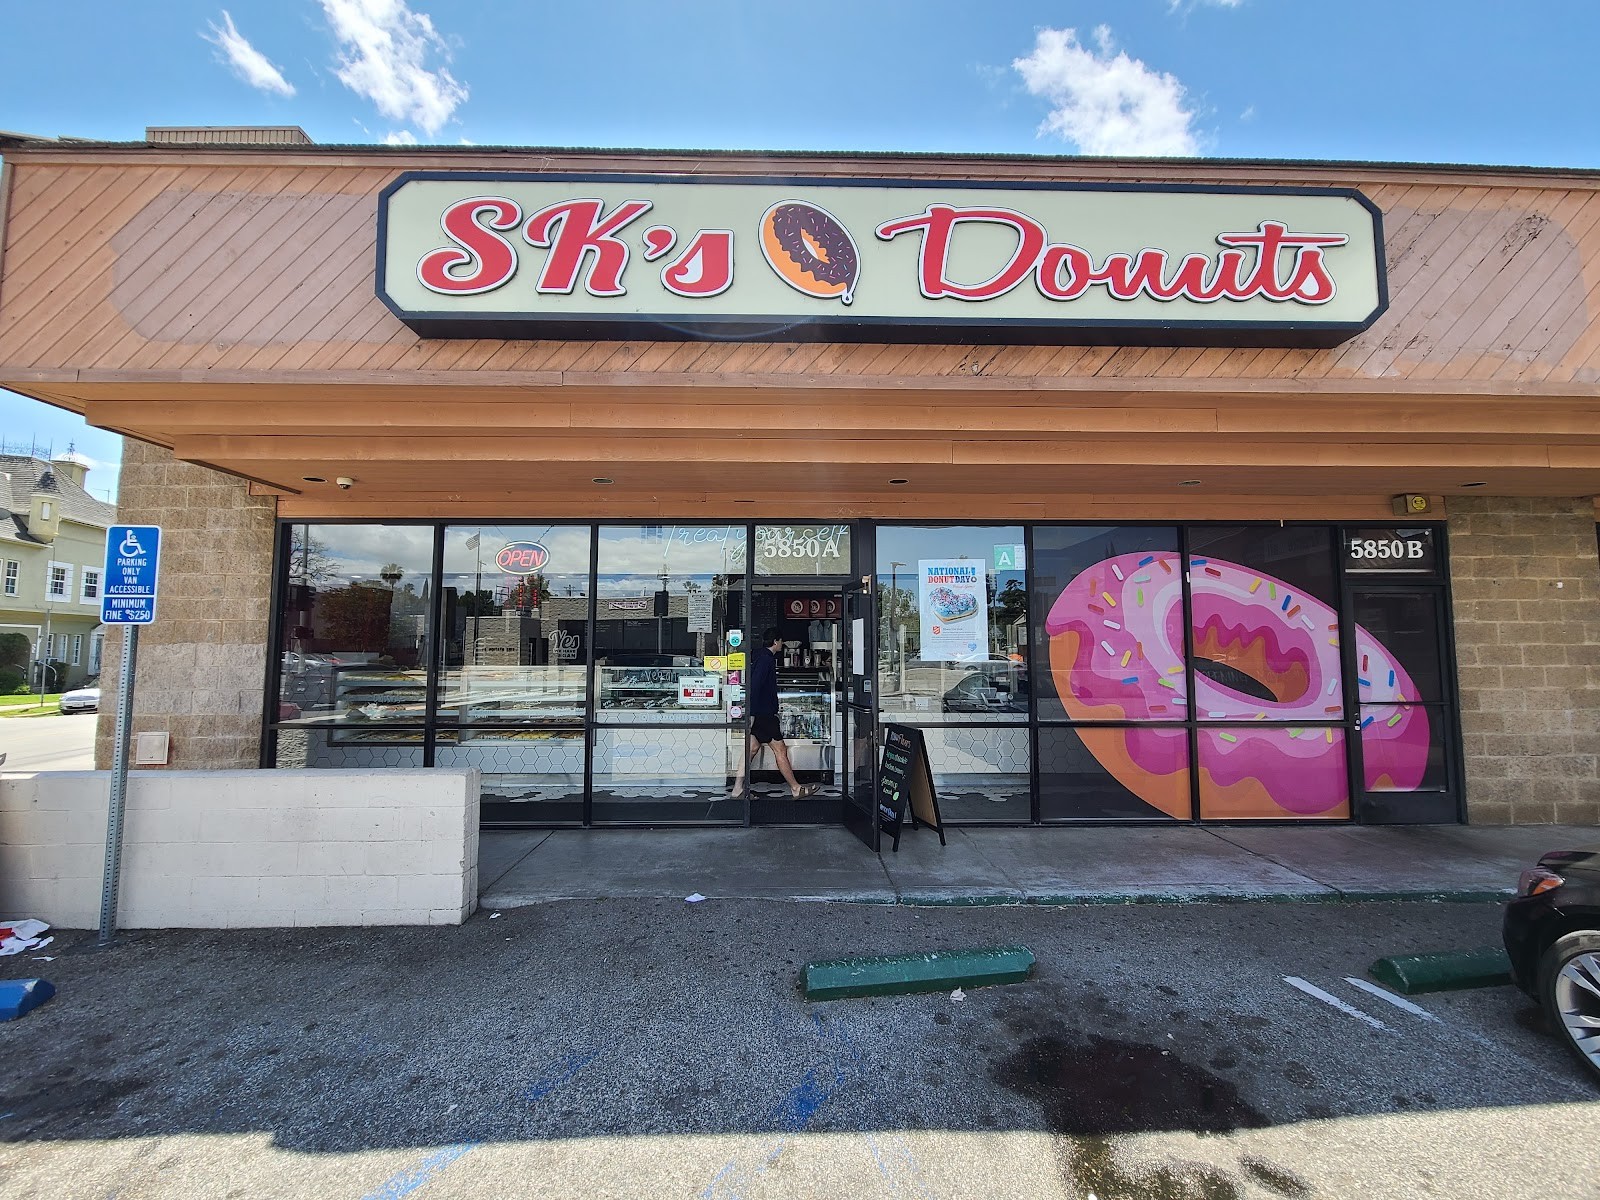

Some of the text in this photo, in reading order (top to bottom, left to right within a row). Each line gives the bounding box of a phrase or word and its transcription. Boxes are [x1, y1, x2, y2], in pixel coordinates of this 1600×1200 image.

[416, 195, 1350, 304] SK's Donuts
[764, 539, 841, 558] 5850 A
[1350, 539, 1424, 559] 5850 B
[117, 558, 147, 567] PARKING
[498, 549, 545, 567] OPEN
[998, 551, 1012, 566] A
[122, 567, 141, 576] ONLY
[123, 576, 138, 585] VAN
[927, 575, 971, 584] DONUT DAY
[109, 585, 150, 594] ACCESSIBLE
[111, 599, 146, 609] MINIMUM
[105, 610, 151, 620] FINE $250
[549, 630, 580, 650] Yes
